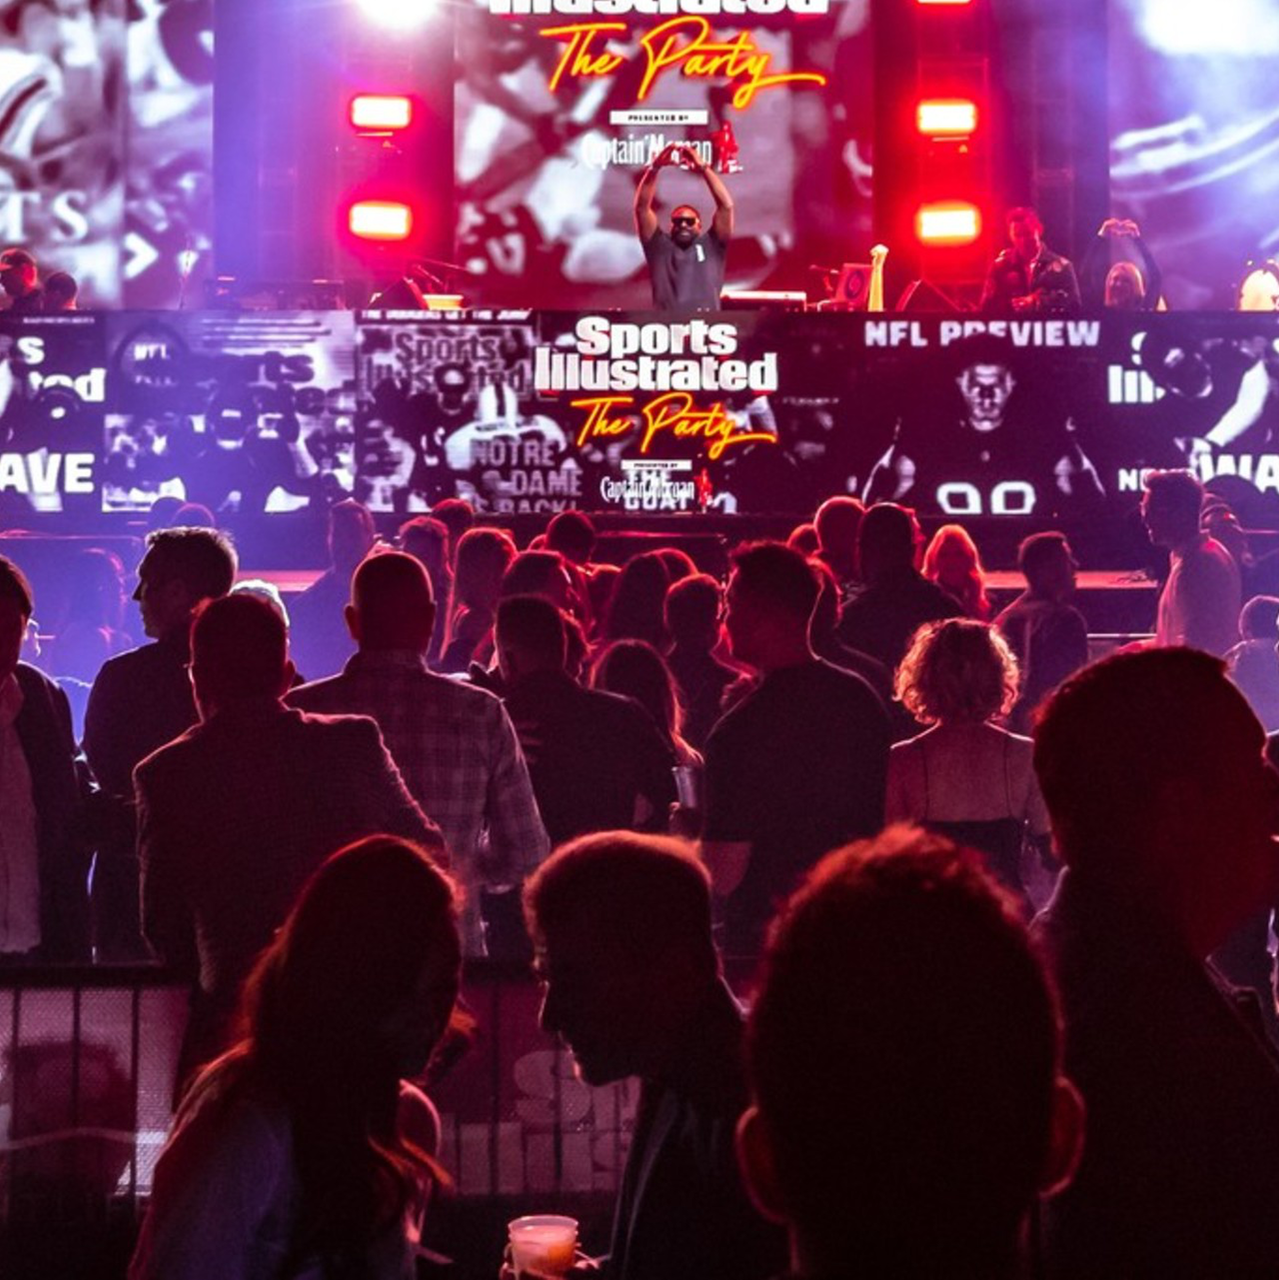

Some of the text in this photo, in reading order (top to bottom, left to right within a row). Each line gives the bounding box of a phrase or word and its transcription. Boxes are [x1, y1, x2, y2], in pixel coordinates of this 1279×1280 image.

[538, 14, 826, 110] The Party
[628, 114, 675, 122] PRESENTED
[646, 133, 712, 170] Man
[394, 331, 497, 364] Sports
[575, 316, 737, 359] Sports
[864, 320, 928, 347] NFL
[533, 346, 779, 392] Illustrated
[571, 392, 778, 460] The Party
[470, 438, 556, 467] NOTRE
[512, 469, 583, 497] DAME
